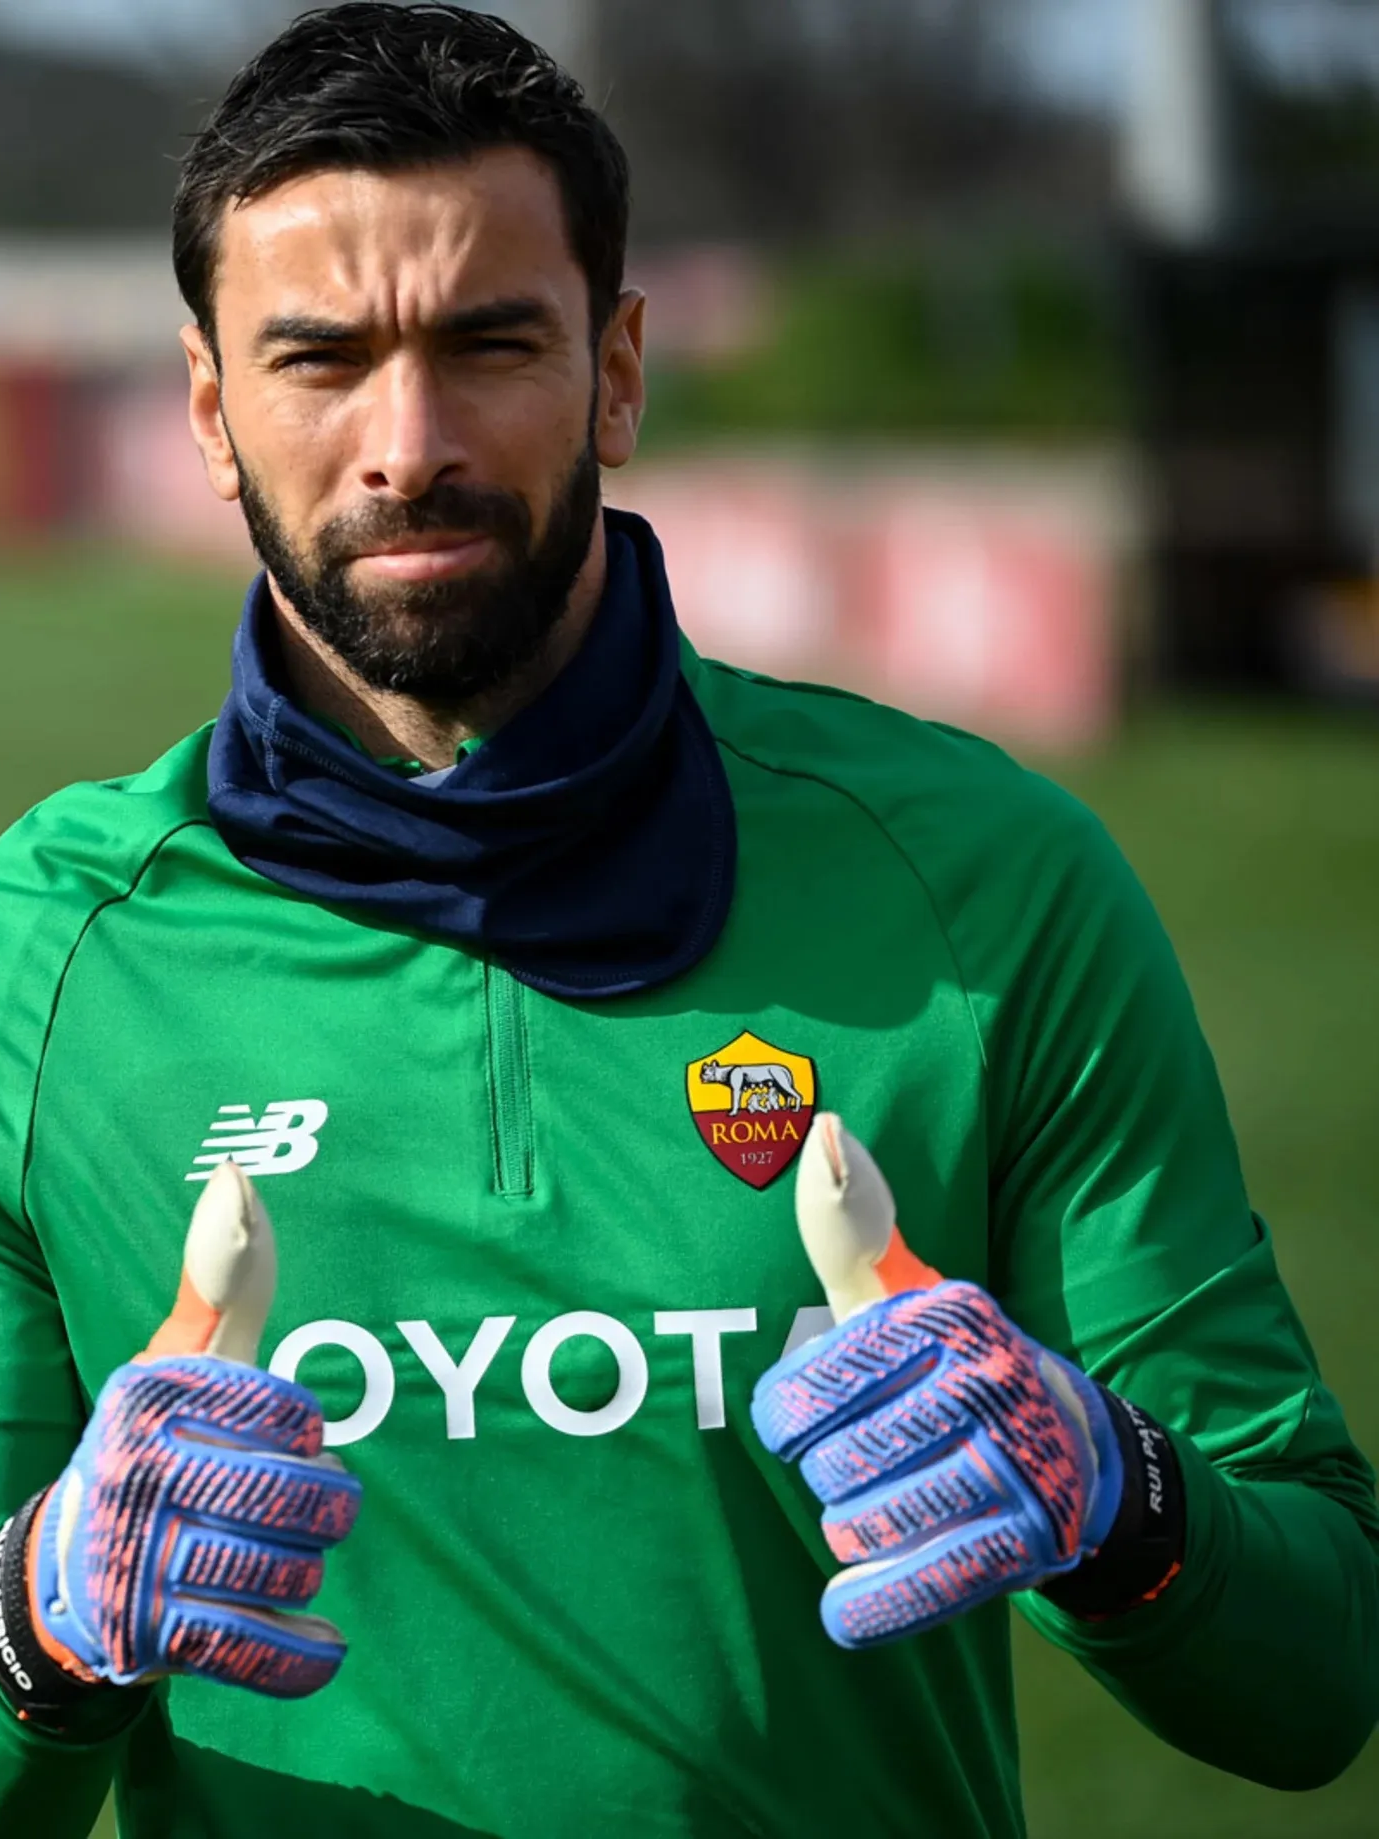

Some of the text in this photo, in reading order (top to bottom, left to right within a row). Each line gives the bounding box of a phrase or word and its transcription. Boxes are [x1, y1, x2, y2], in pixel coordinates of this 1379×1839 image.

[711, 1119, 799, 1145] ROMA
[740, 1151, 773, 1165] 1927
[267, 1305, 837, 1447] OYOT
[1147, 1463, 1162, 1514] RUI
